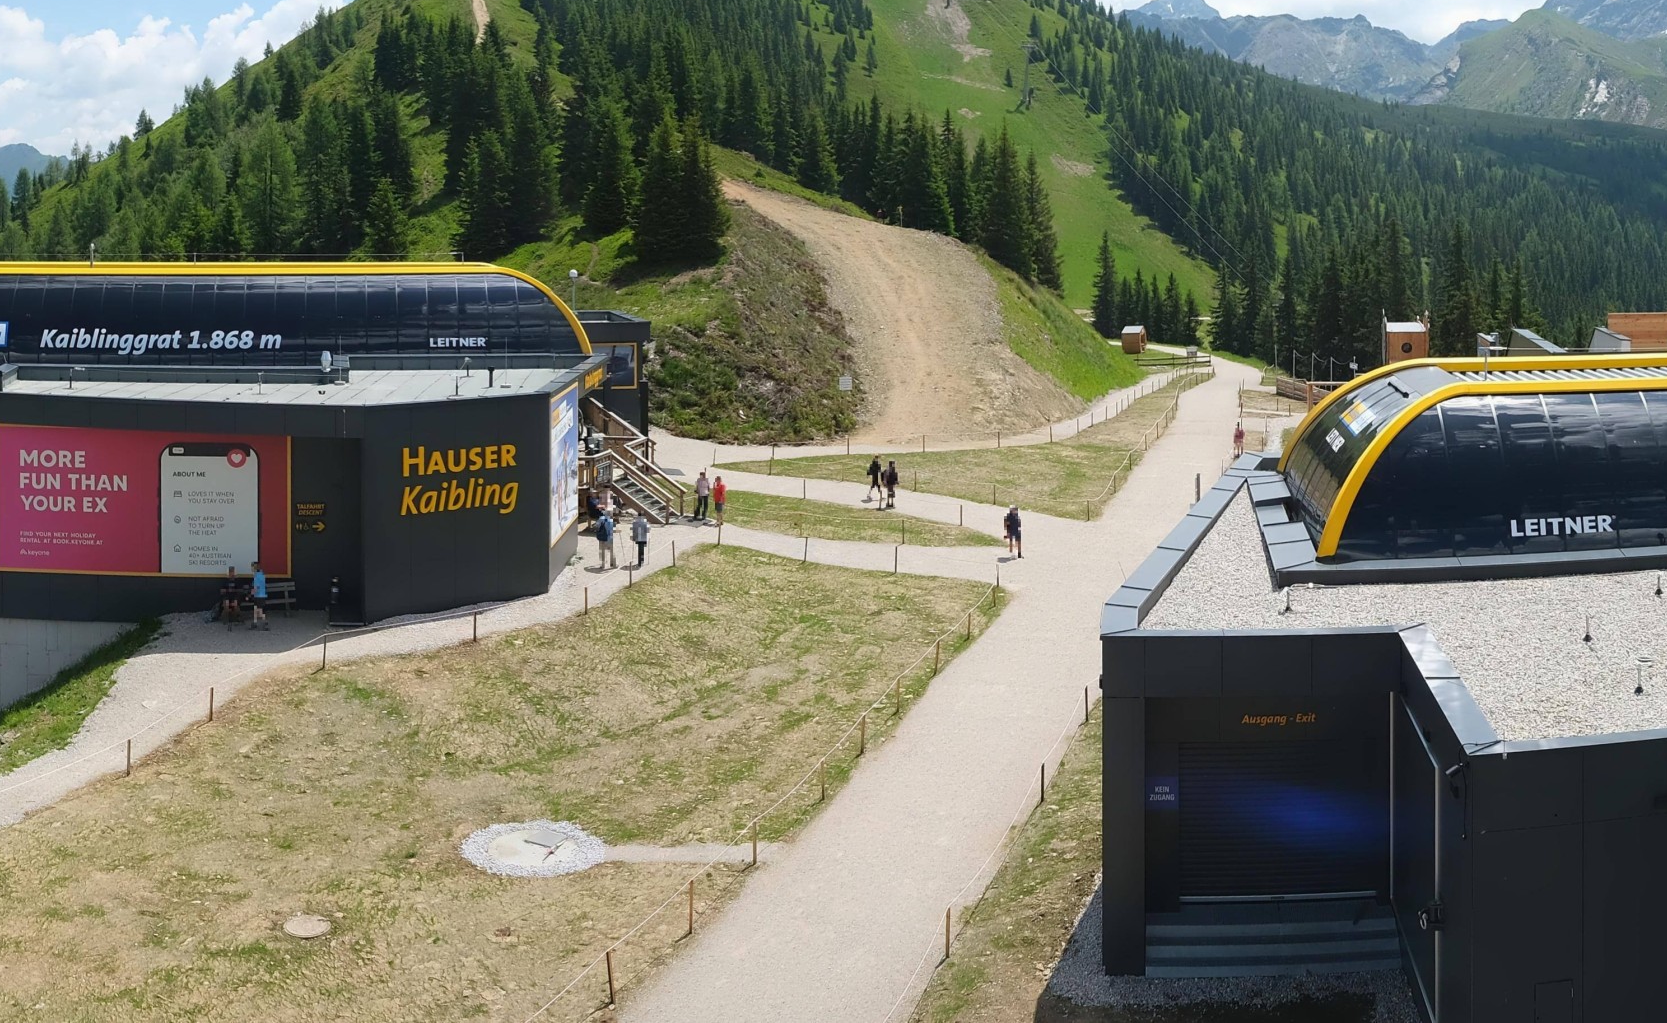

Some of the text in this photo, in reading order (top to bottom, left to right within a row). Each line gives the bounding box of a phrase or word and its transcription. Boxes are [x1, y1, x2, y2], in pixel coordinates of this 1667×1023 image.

[40, 328, 282, 355] Kaiblinggrat 1.868 m
[429, 337, 486, 347] LEITNER
[20, 449, 86, 468] MORE
[402, 444, 518, 477] HAUSER
[20, 473, 128, 491] FUN THAN
[20, 495, 108, 513] YOUR EX
[400, 477, 519, 516] Kaibling
[1510, 515, 1614, 537] LEITNER
[28, 549, 50, 557] keyone
[1241, 714, 1287, 727] Ausgang
[1296, 712, 1317, 723] Exit
[1149, 793, 1175, 801] ZUGANG
